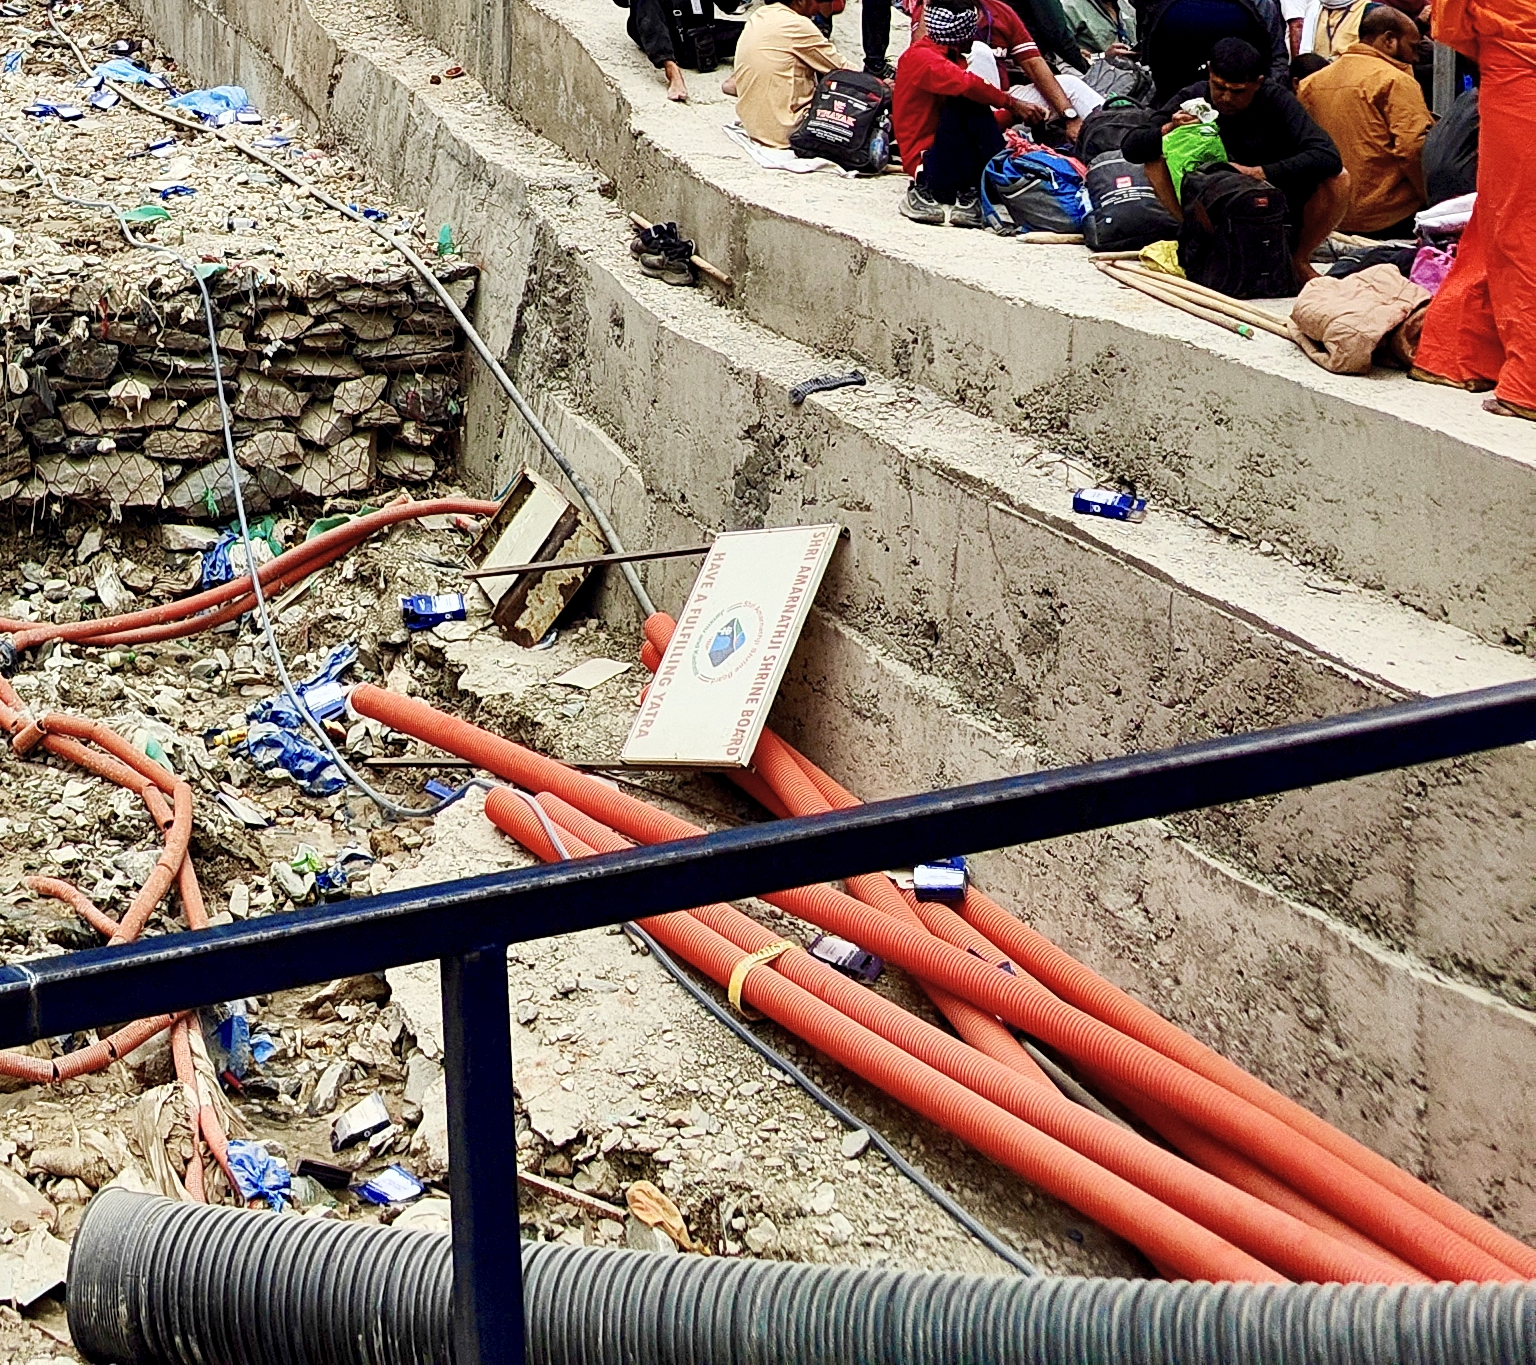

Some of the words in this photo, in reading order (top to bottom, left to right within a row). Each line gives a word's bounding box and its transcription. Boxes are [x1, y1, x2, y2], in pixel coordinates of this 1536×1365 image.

[803, 530, 826, 561] SHRI
[701, 552, 726, 589] HAVE
[694, 594, 708, 603] A
[658, 608, 702, 686] FULFILLING
[745, 654, 776, 705] SHRINE
[635, 691, 667, 739] YATRA
[726, 709, 755, 757] BOARD
